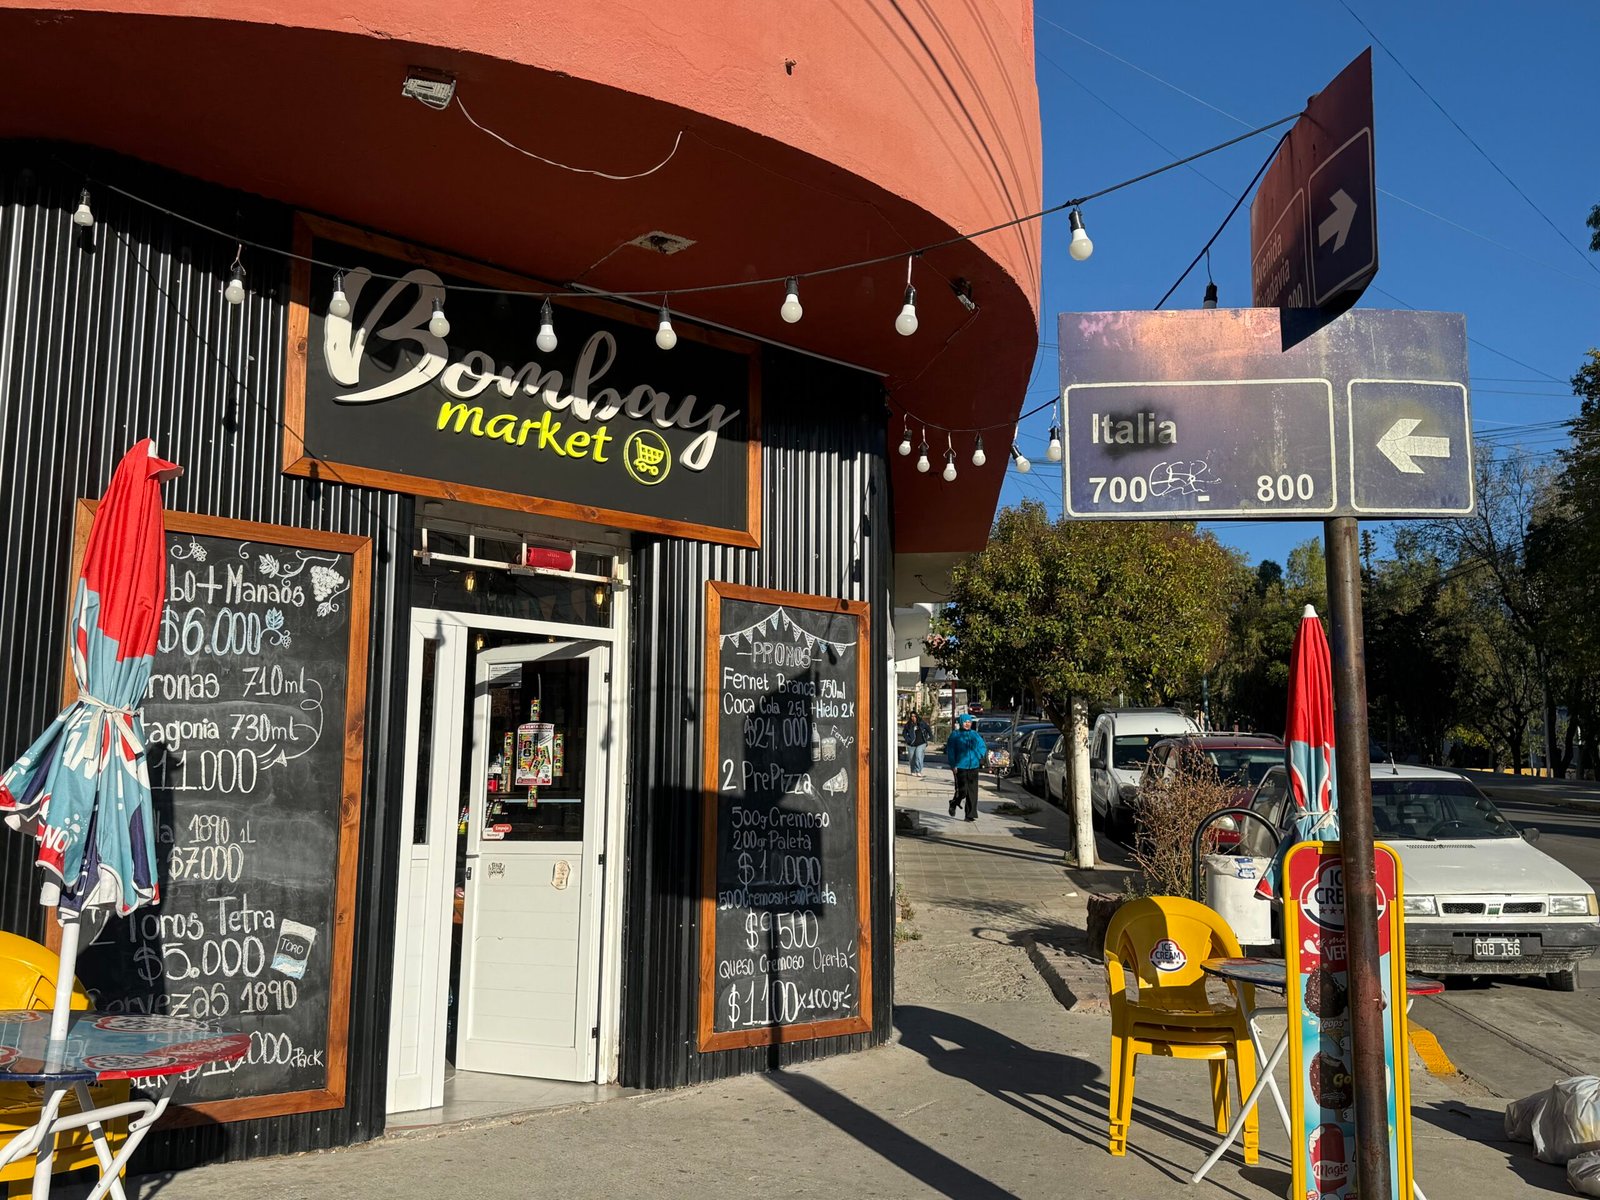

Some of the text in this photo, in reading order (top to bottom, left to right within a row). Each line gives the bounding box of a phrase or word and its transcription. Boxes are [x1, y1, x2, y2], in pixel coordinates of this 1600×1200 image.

[1256, 232, 1282, 288] Avenida
[323, 267, 739, 471] Bombay
[436, 401, 613, 463] market
[1092, 413, 1178, 444] Italia
[1089, 476, 1147, 503] 700
[1257, 474, 1314, 501] 800
[157, 605, 261, 656] $6.000
[144, 664, 306, 700] ronas 710ml
[723, 666, 769, 691] Fernet
[776, 673, 816, 698] Branca
[723, 692, 755, 715] Coca
[759, 695, 780, 714] Cola
[140, 707, 299, 751] tagonia 730ml
[721, 758, 737, 791] 2
[189, 814, 230, 844] 1890
[769, 807, 829, 829] Cremoso
[768, 829, 812, 851] Paleta
[168, 842, 244, 883] $7.000
[1330, 869, 1344, 887] IC
[1314, 888, 1345, 905] CRE
[207, 895, 276, 936] Tetra
[132, 936, 266, 986] $5.000
[280, 937, 305, 955] TORO
[760, 954, 804, 973] Cremoso
[813, 947, 848, 973] Oferta
[1155, 951, 1180, 960] CREAM
[1162, 943, 1173, 952] ICE
[1501, 943, 1521, 956] 156
[240, 979, 298, 1013] 1890
[1313, 1163, 1348, 1178] Magic
